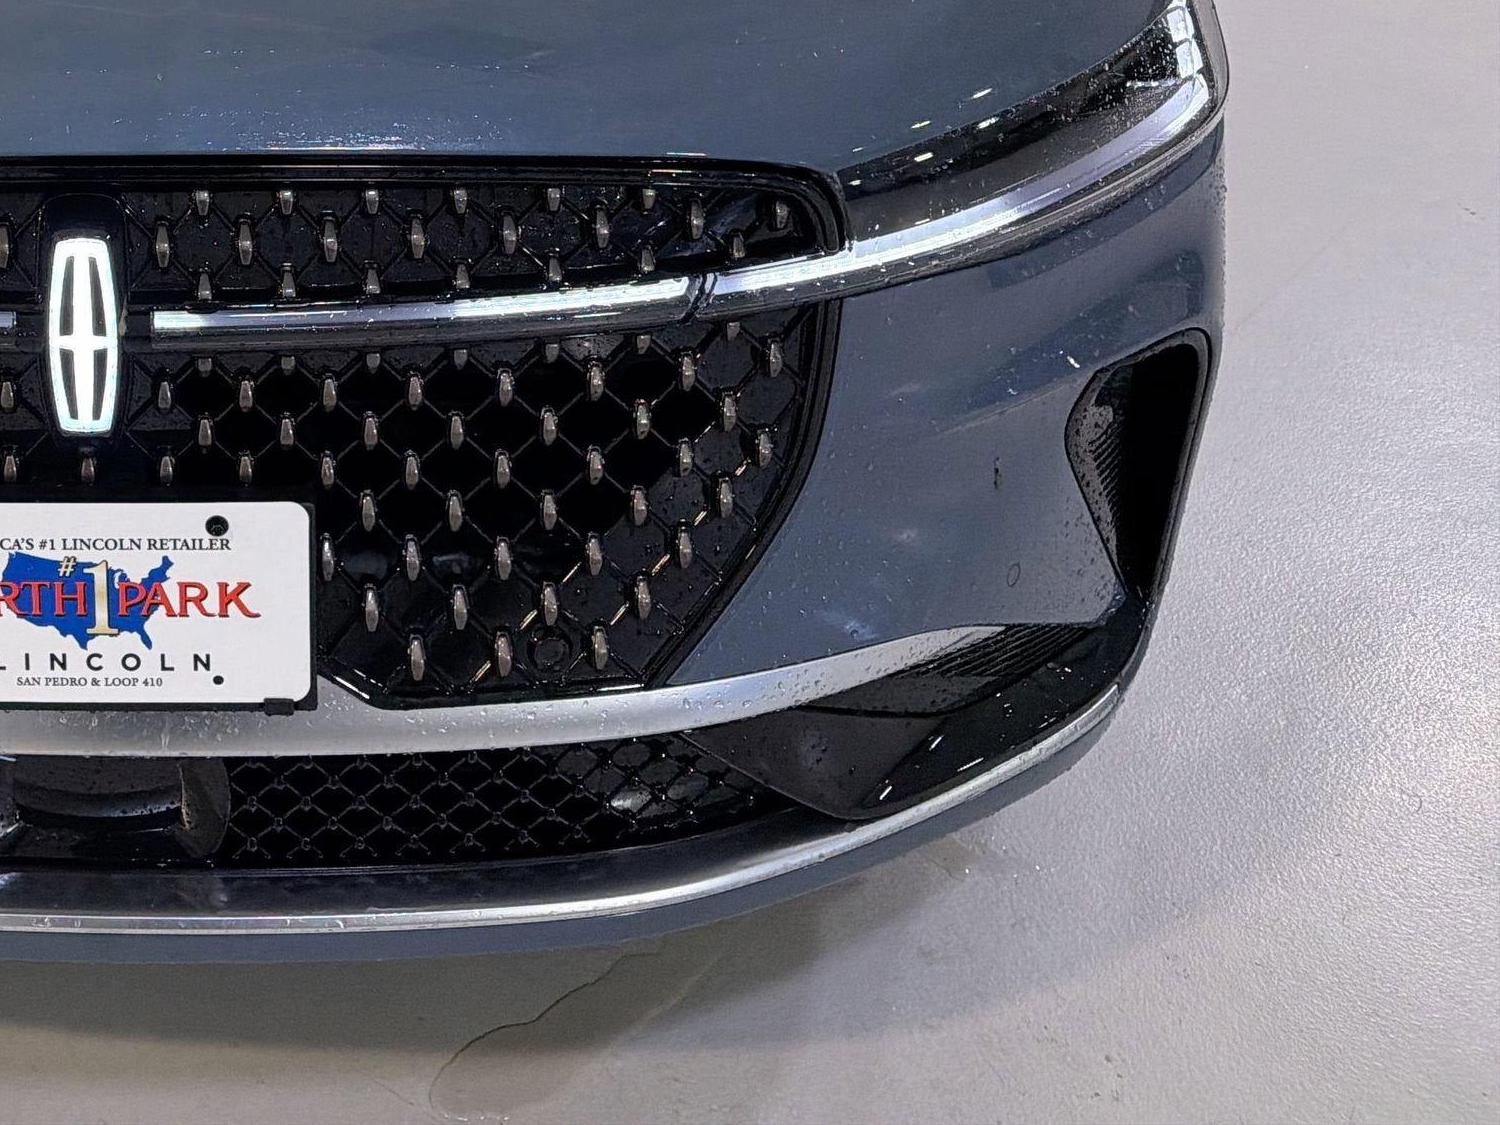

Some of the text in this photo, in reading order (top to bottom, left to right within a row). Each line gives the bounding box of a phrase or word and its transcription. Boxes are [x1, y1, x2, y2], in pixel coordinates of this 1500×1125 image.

[39, 538, 56, 551] #1
[61, 538, 143, 551] LINCOLN
[147, 538, 231, 551] RETAILER
[117, 581, 262, 618] PARK
[16, 676, 163, 687] SAN PEDRO & LOOP 410
